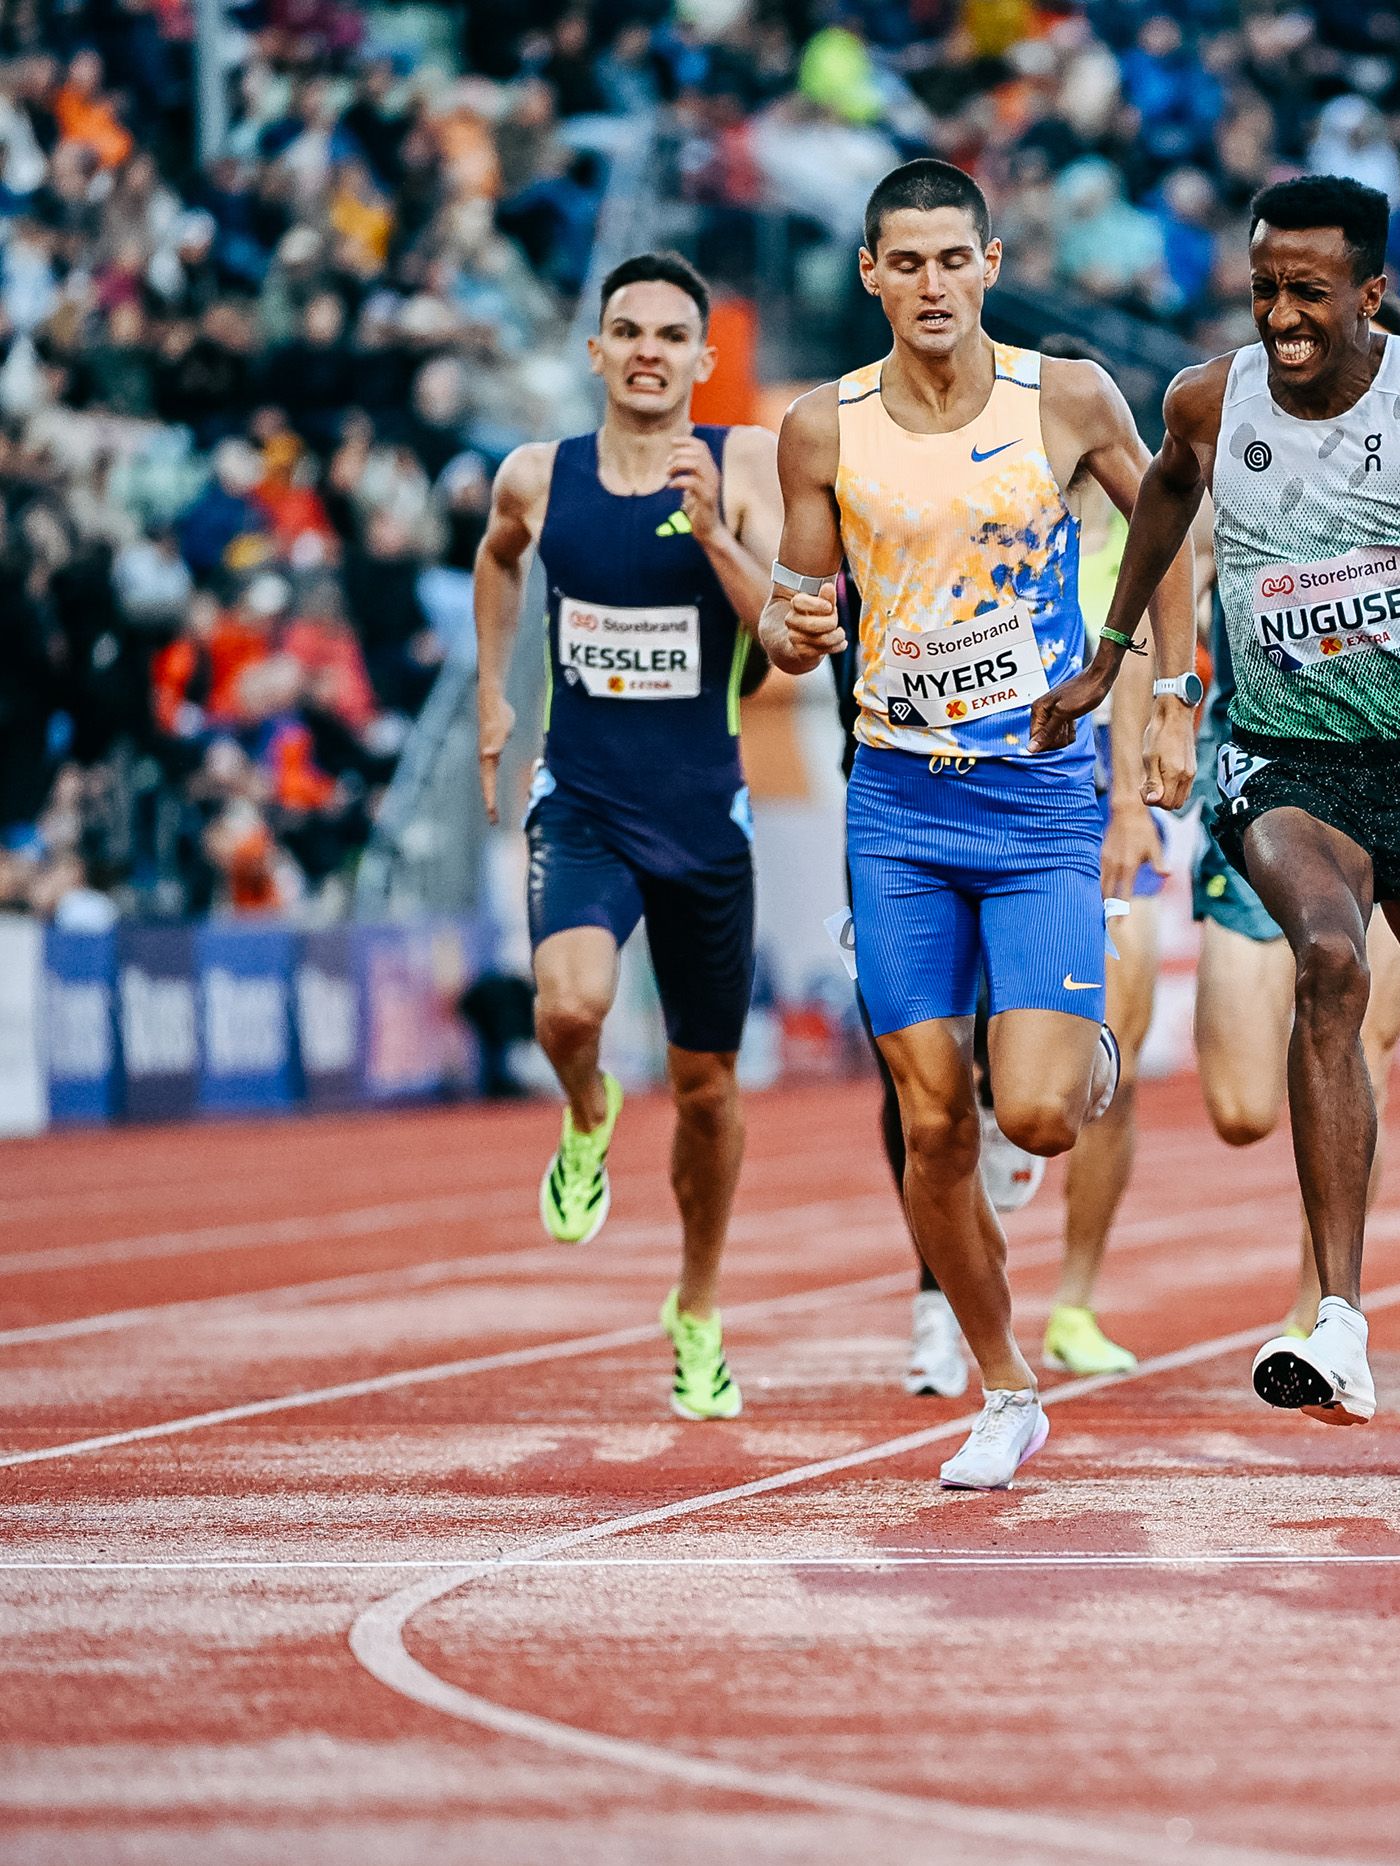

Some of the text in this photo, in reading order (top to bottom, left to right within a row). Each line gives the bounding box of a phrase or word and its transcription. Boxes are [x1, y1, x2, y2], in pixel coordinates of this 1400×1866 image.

[1299, 556, 1397, 589] Storebrand
[602, 617, 689, 633] Storebrand
[926, 615, 1020, 656] Storebrand
[1346, 631, 1391, 647] EXTRA
[569, 642, 688, 672] KESSLER
[902, 650, 1018, 699] MYERS
[971, 688, 1018, 710] EXTRA
